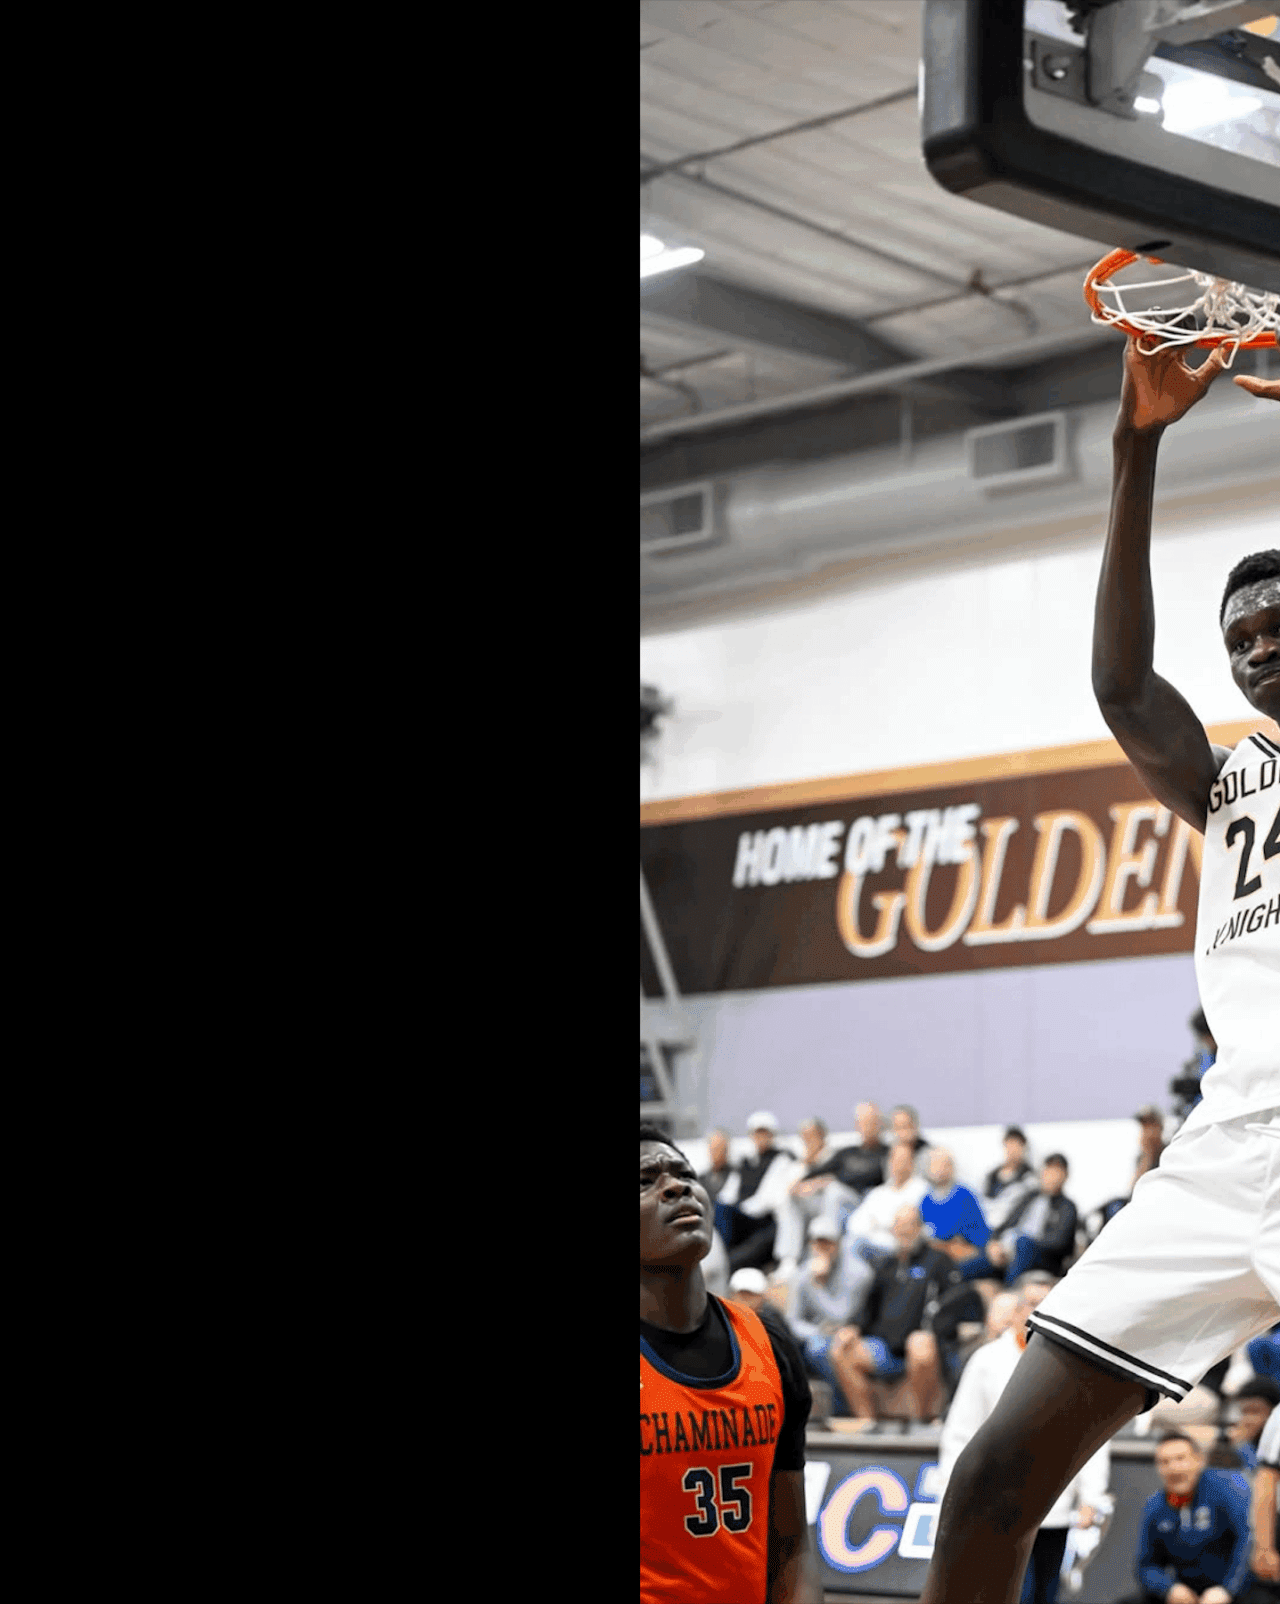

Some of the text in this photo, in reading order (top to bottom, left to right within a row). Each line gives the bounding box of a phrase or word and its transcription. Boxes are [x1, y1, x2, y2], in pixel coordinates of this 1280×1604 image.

[733, 802, 982, 887] HOME OF THE
[681, 1461, 754, 1538] 35
